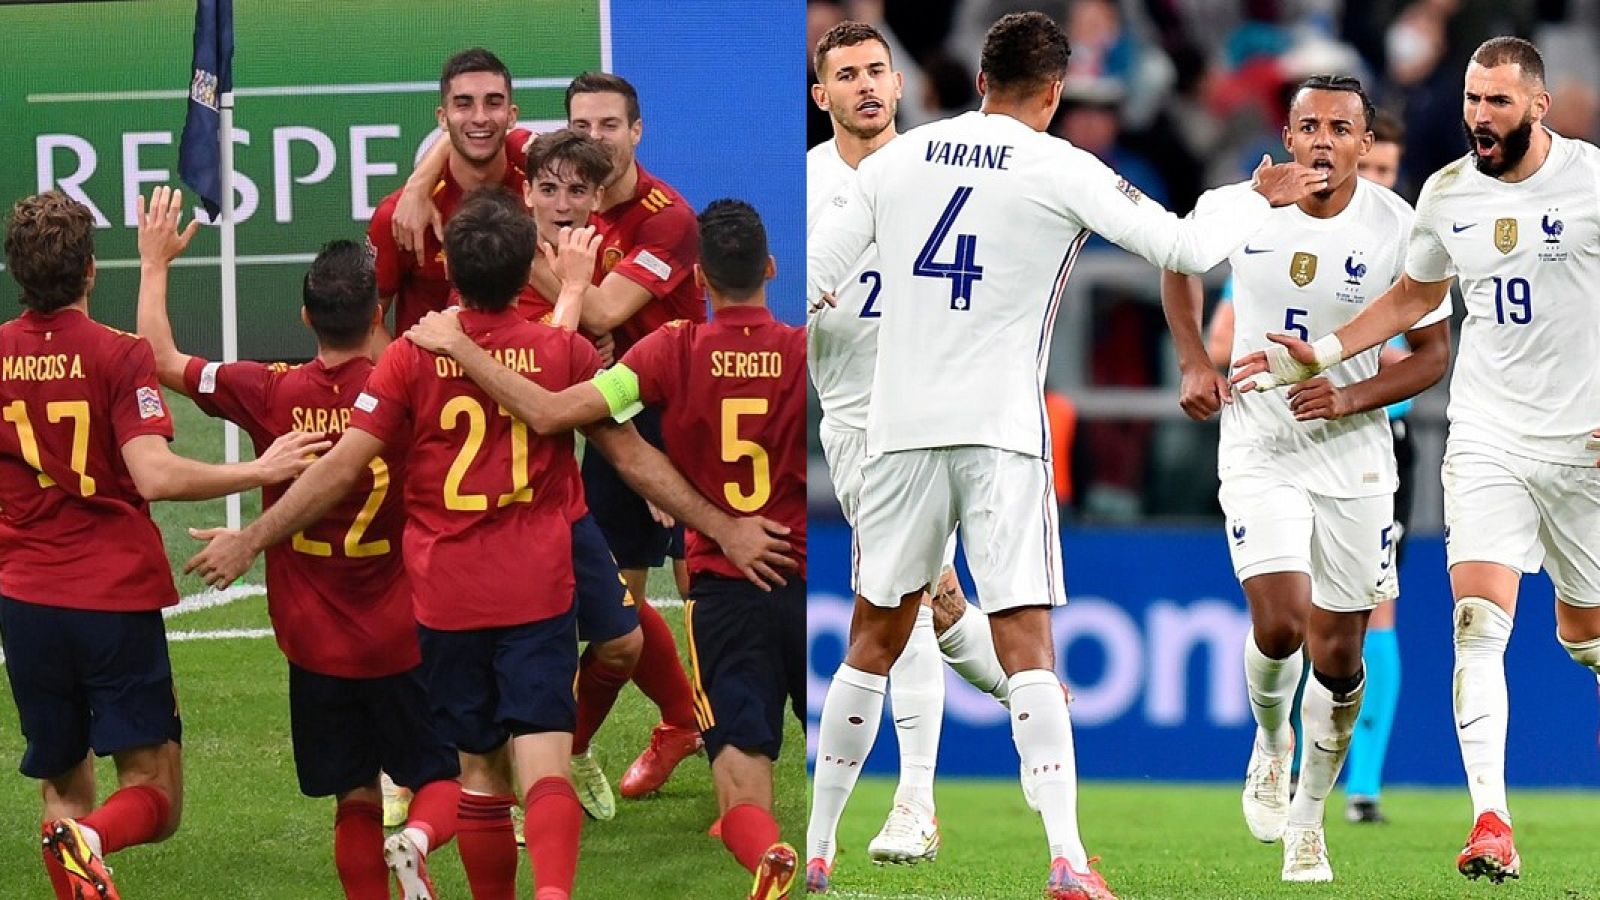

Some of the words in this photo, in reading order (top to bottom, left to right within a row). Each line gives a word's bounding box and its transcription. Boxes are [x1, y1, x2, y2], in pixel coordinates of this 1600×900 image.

[36, 122, 568, 228] RESPE
[924, 141, 1014, 170] VARANE
[912, 185, 983, 311] 4
[1493, 276, 1532, 325] 19
[2, 354, 67, 381] MARCOS
[711, 350, 782, 378] SERGIO
[3, 400, 97, 497] 17
[292, 406, 355, 432] SARAB
[440, 395, 534, 511] 21
[721, 398, 771, 512] 5
